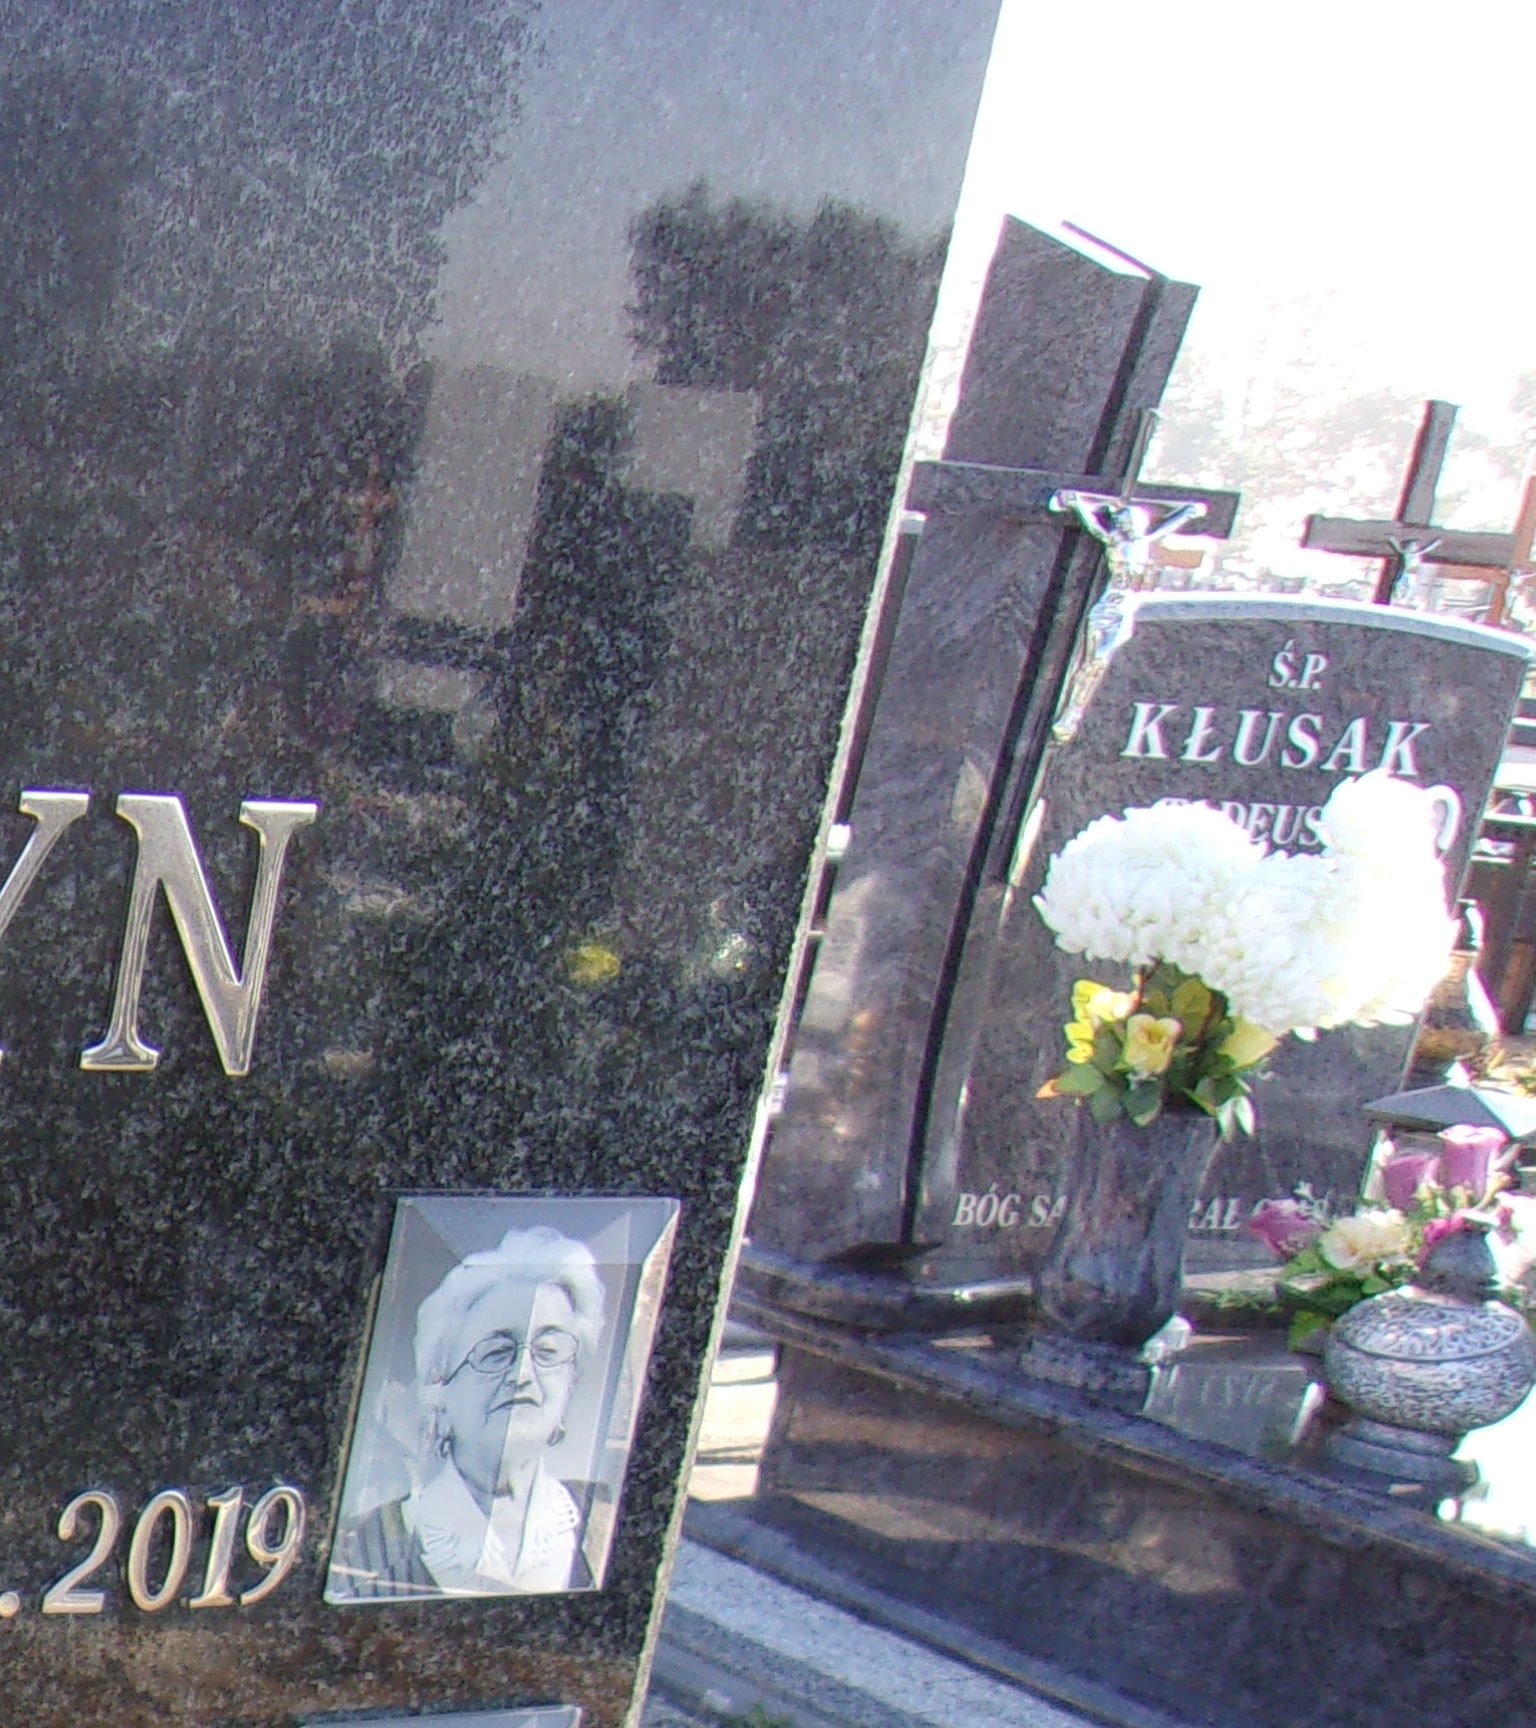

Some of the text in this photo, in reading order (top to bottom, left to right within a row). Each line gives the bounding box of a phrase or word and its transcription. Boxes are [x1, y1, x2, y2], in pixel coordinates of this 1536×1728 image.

[1268, 638, 1327, 691] Ś.P.
[1119, 700, 1430, 776] KŁUSAK
[951, 1181, 1022, 1228] BÓG
